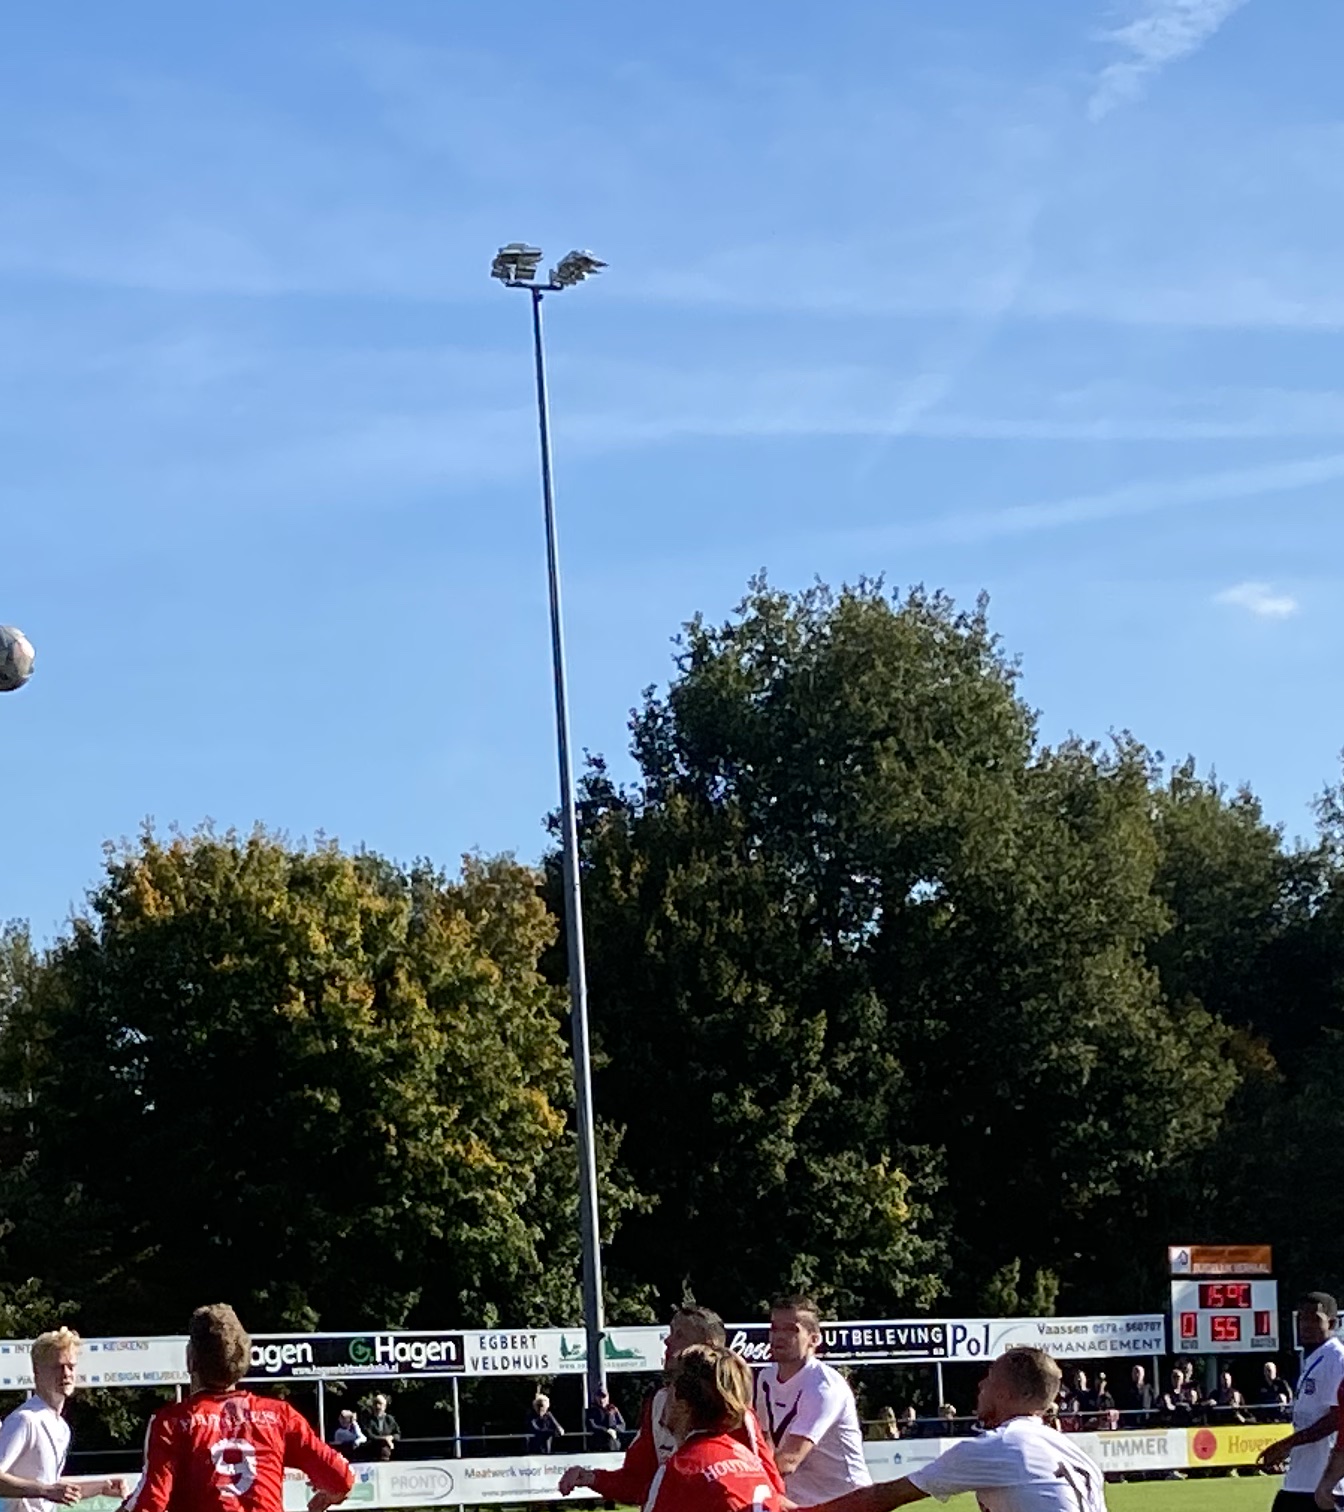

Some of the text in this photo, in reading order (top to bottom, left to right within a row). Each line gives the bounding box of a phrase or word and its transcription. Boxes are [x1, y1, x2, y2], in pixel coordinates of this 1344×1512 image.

[1037, 1322, 1088, 1335] Vaassen
[1182, 1314, 1196, 1337] 0
[1213, 1317, 1238, 1340] 55
[478, 1334, 538, 1350] EGBERT
[950, 1324, 990, 1357] Pol
[250, 1341, 313, 1374] agen
[471, 1354, 549, 1371] VELDHUIS
[103, 1372, 141, 1382] DESIGN
[1099, 1437, 1169, 1457] TIMMER
[210, 1437, 256, 1496] 9
[519, 1466, 542, 1478] voor
[391, 1475, 449, 1490] PRONTO
